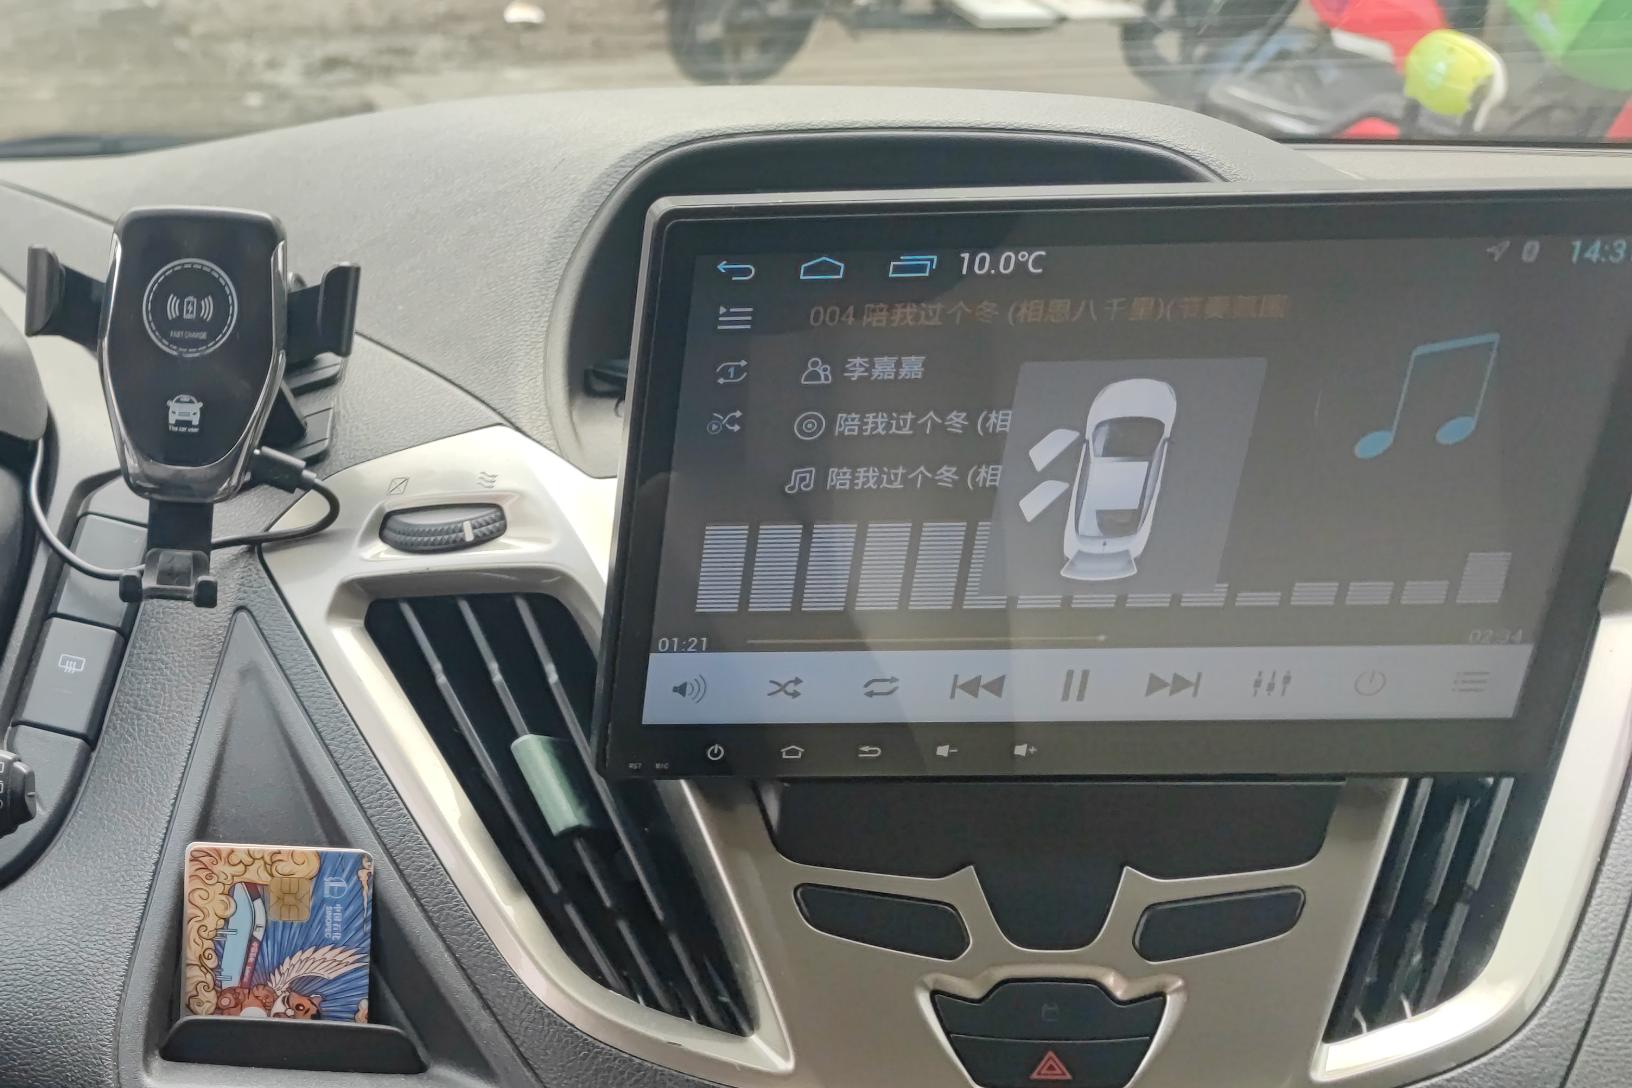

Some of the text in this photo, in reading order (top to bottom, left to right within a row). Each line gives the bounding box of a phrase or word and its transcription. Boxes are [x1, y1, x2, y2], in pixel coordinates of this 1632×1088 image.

[1571, 239, 1632, 264] 14:3
[809, 305, 856, 327] 004
[861, 300, 1000, 328] 陪我过个冬
[843, 354, 925, 382] 李嘉嘉
[834, 410, 969, 438] 陪我过个冬
[825, 465, 960, 492] 陪我过个冬
[658, 637, 707, 652] 01:21
